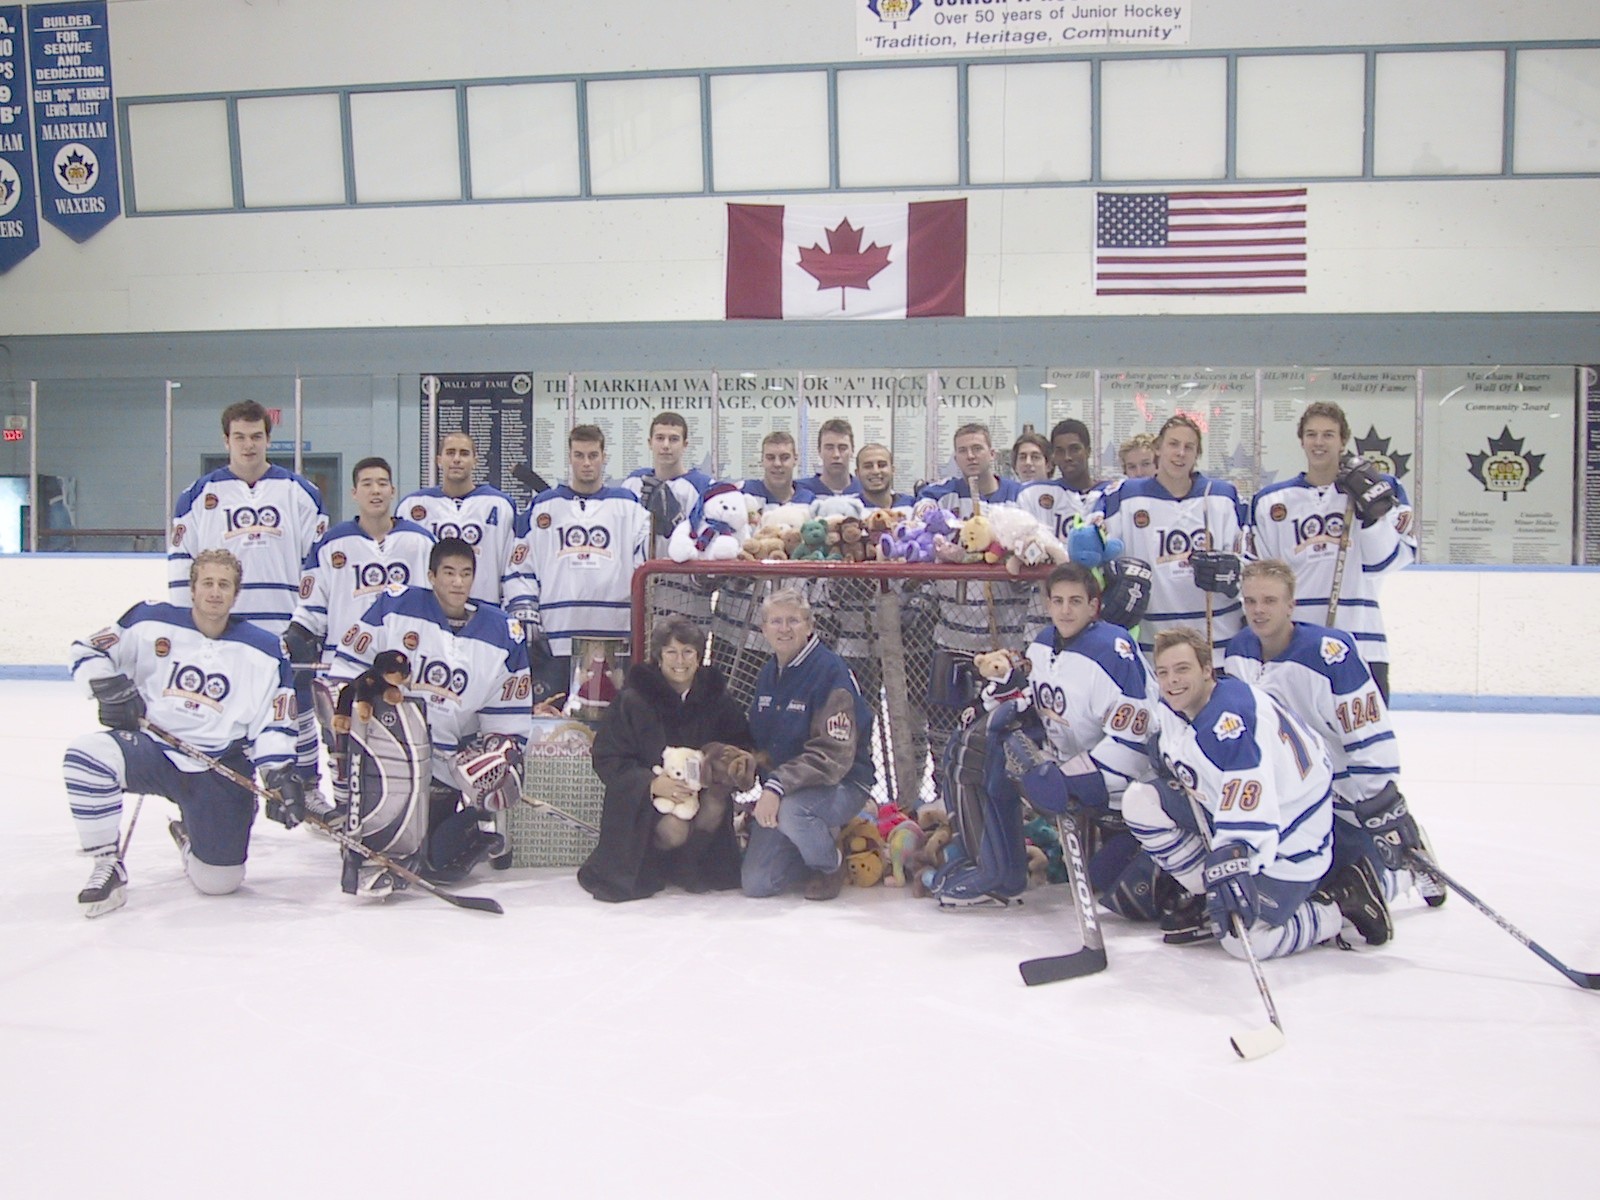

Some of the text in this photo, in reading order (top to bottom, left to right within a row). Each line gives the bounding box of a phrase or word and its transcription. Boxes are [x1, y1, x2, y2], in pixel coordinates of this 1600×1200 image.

[43, 15, 92, 28] BUILDER
[934, 4, 1182, 25] Over 50 years of Junior Hockey
[56, 30, 80, 43] FOR
[966, 30, 1052, 44] Heritage,
[43, 41, 93, 55] SERVICE
[57, 54, 82, 67] AND
[35, 65, 105, 80] DEDICATION
[42, 121, 108, 141] MARKHAM
[55, 196, 106, 215] WAXERS
[583, 378, 678, 393] MARKHAM
[871, 375, 950, 391] HOCKY
[955, 375, 1006, 390] CLUB
[1332, 372, 1417, 381] Markham Waxers
[444, 380, 509, 389] WALL OF FAME
[1341, 383, 1408, 393] Wall Of Fame
[1475, 383, 1496, 392] Wall
[1498, 383, 1513, 393] Of
[1465, 402, 1519, 413] Community
[223, 505, 281, 532] 100
[485, 506, 498, 526] A
[556, 525, 611, 551] 100
[352, 561, 410, 590] 100
[167, 661, 231, 702] 100
[1219, 778, 1262, 812] 13
